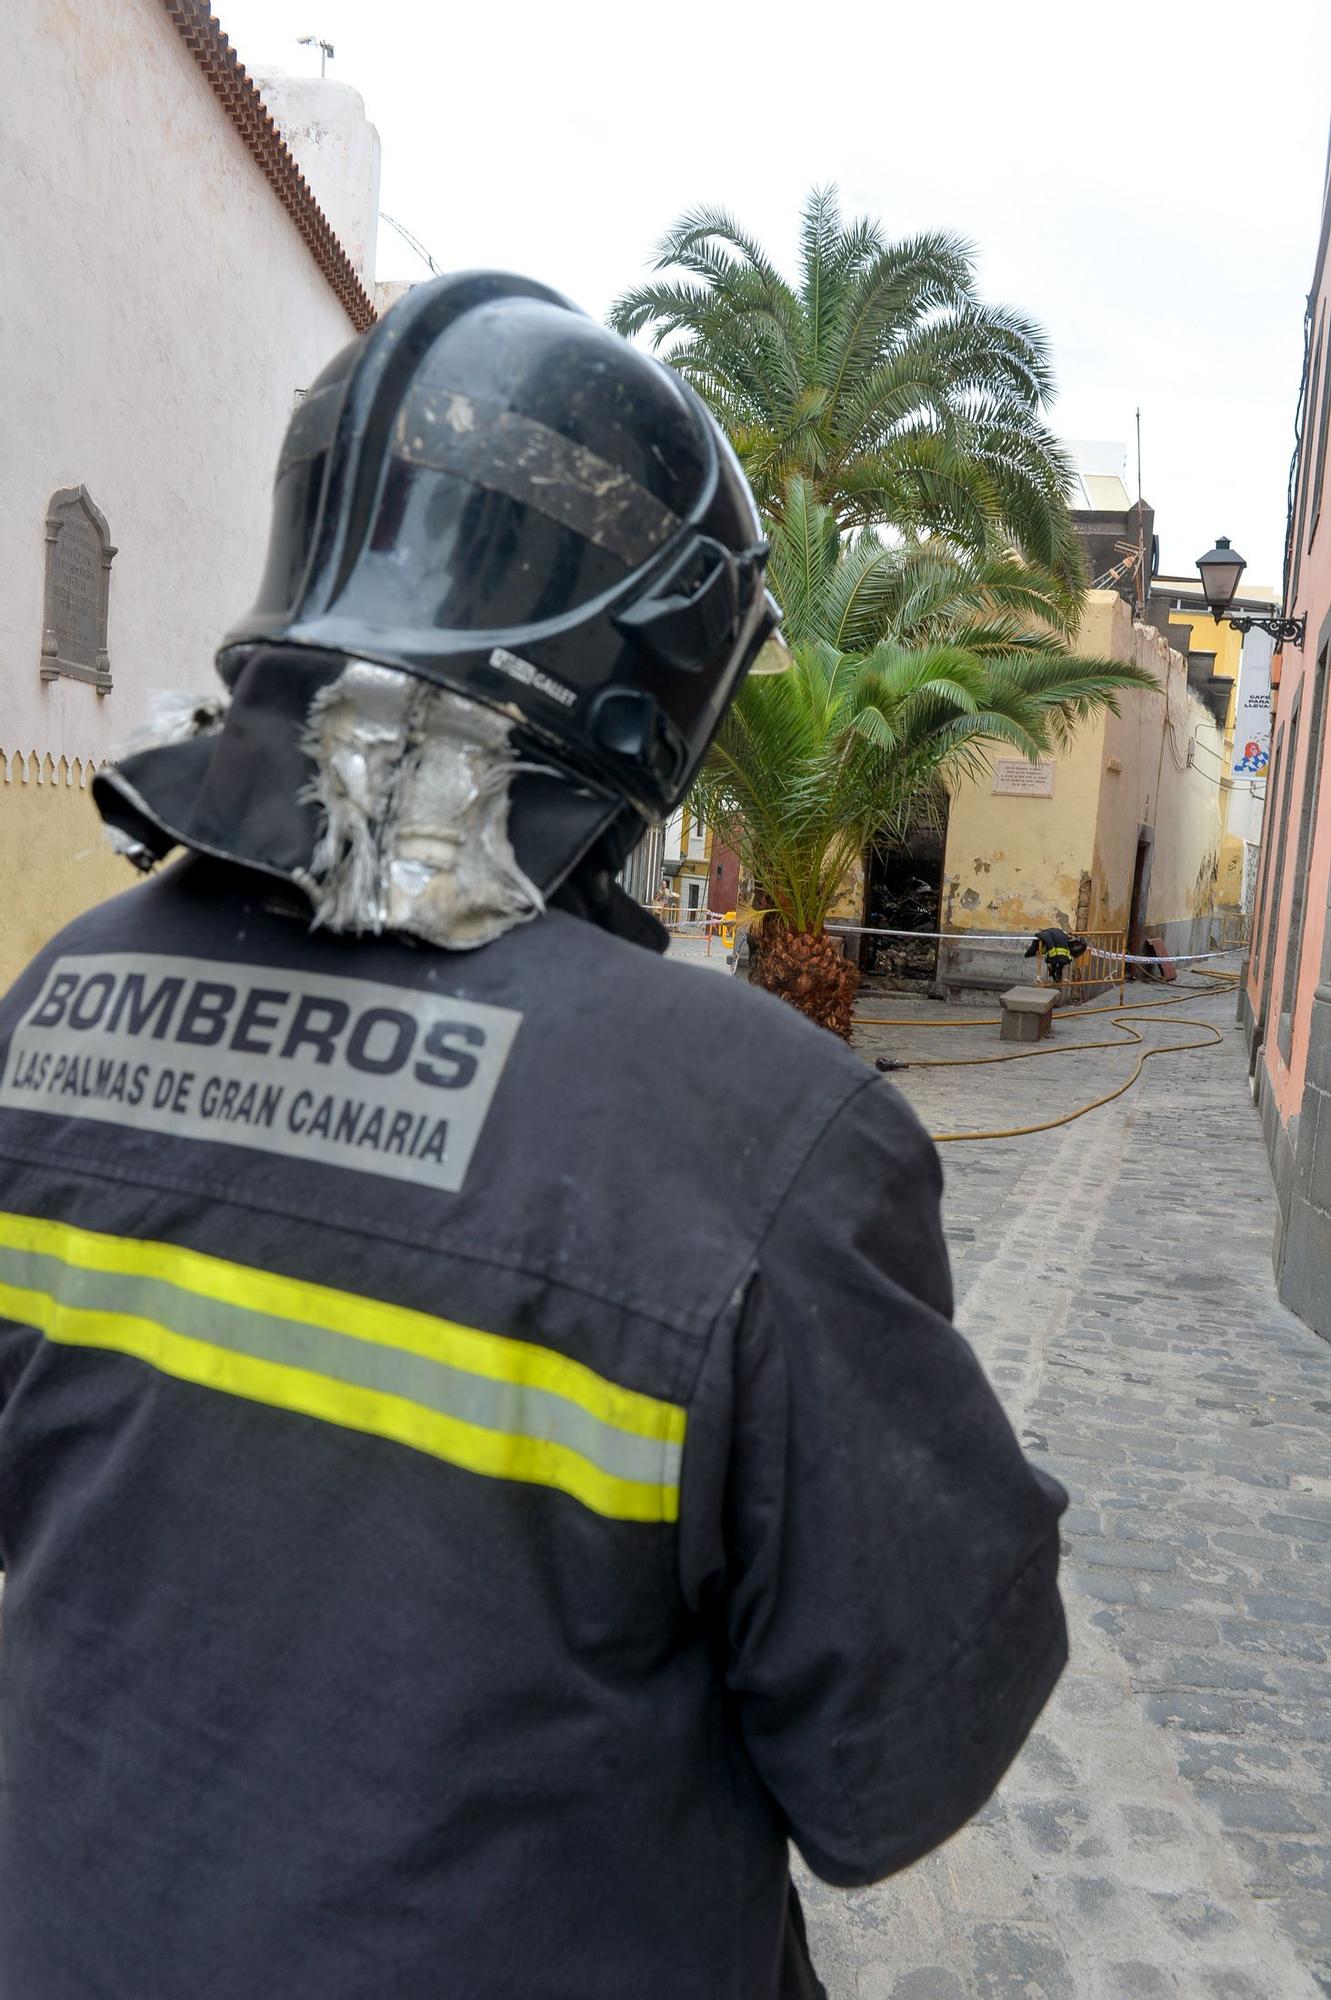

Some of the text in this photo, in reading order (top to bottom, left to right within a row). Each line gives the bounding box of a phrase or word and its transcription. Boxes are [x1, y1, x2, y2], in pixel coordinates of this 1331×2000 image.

[28, 973, 487, 1090] BOMBEROS
[11, 1050, 450, 1165] LAS PALMAS DE GRAN CANARIA
